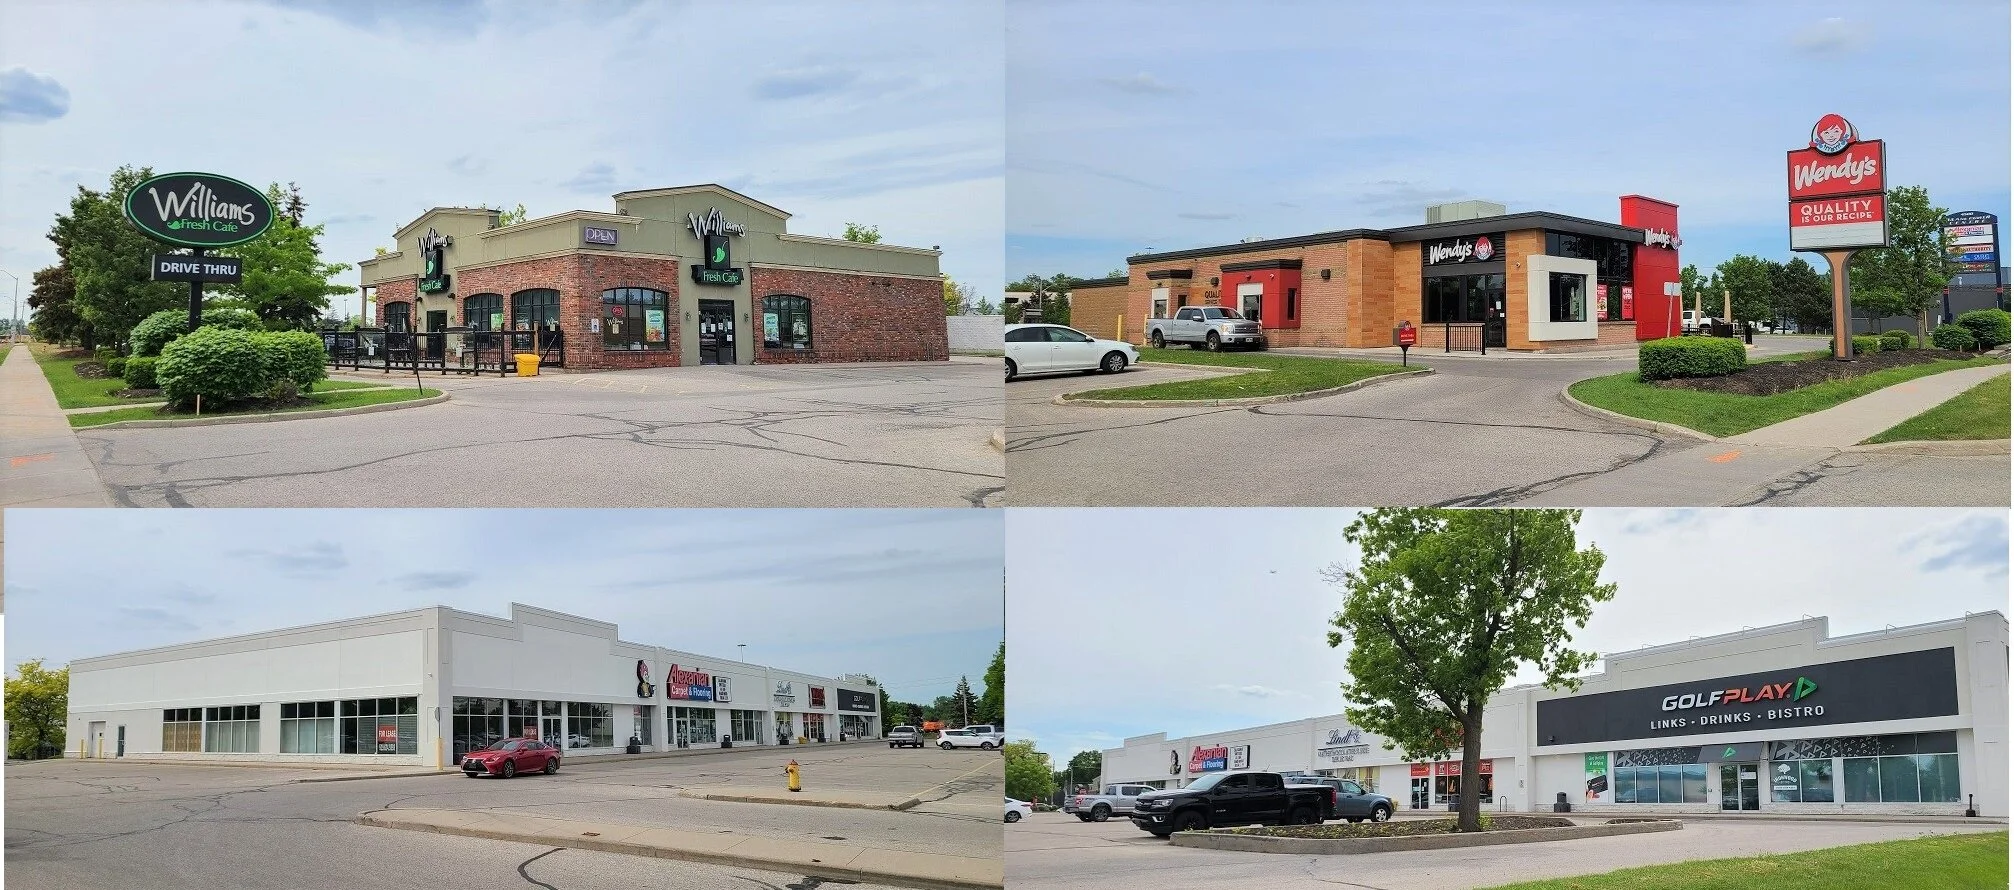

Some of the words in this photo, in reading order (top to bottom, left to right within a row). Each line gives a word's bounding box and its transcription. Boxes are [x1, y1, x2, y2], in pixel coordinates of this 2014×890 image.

[1794, 152, 1877, 190] Wendy's
[149, 181, 255, 225] Williams
[1800, 200, 1872, 217] QUALITY
[688, 206, 746, 240] Williams
[1812, 213, 1833, 222] OUR
[1836, 211, 1873, 221] RECIPE
[181, 218, 211, 231] Fresh
[213, 220, 238, 233] Cafe
[586, 228, 616, 242] OPEN
[1645, 227, 1671, 248] Wendy's
[1430, 238, 1473, 265] Wendy's
[160, 261, 200, 274] DRIVE
[203, 263, 237, 276] THRU
[703, 271, 721, 282] Fresh
[722, 272, 739, 283] Cafe
[669, 664, 710, 687] Alexanian
[671, 684, 689, 698] Carpet
[688, 686, 693, 696] &
[692, 687, 711, 700] Flooring
[1661, 682, 1793, 712] GOLFPLAY
[1650, 718, 1687, 730] LINKS
[1700, 712, 1751, 726] DRINKS
[1768, 705, 1825, 720] BISTRO
[1191, 745, 1227, 762] Alexanian
[1189, 762, 1203, 771] Carpet
[1206, 759, 1224, 769] Flooring
